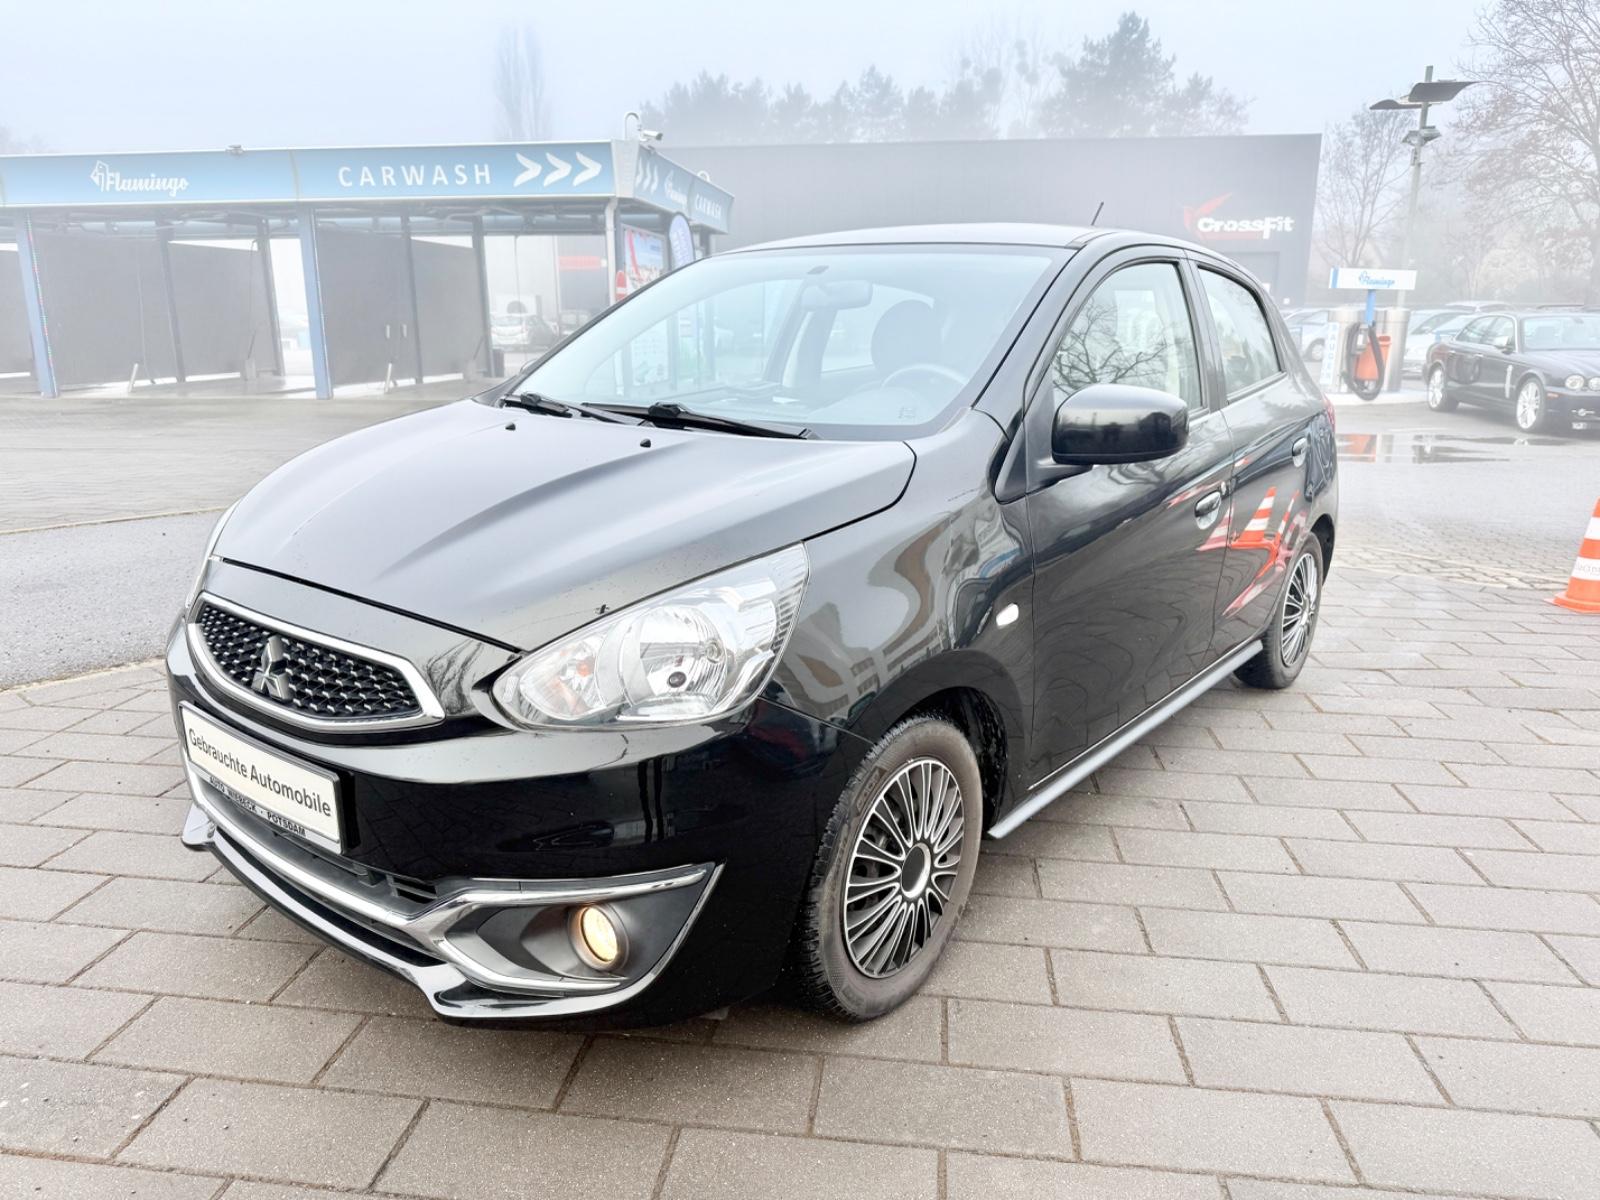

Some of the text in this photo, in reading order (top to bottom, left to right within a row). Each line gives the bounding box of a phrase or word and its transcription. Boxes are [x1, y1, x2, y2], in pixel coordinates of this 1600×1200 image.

[105, 172, 190, 198] Flamingo
[337, 163, 492, 188] CARWASH
[1197, 216, 1295, 240] CrossFit
[188, 727, 331, 817] Gebrauchte Automobile
[267, 810, 307, 838] POTSDAM
